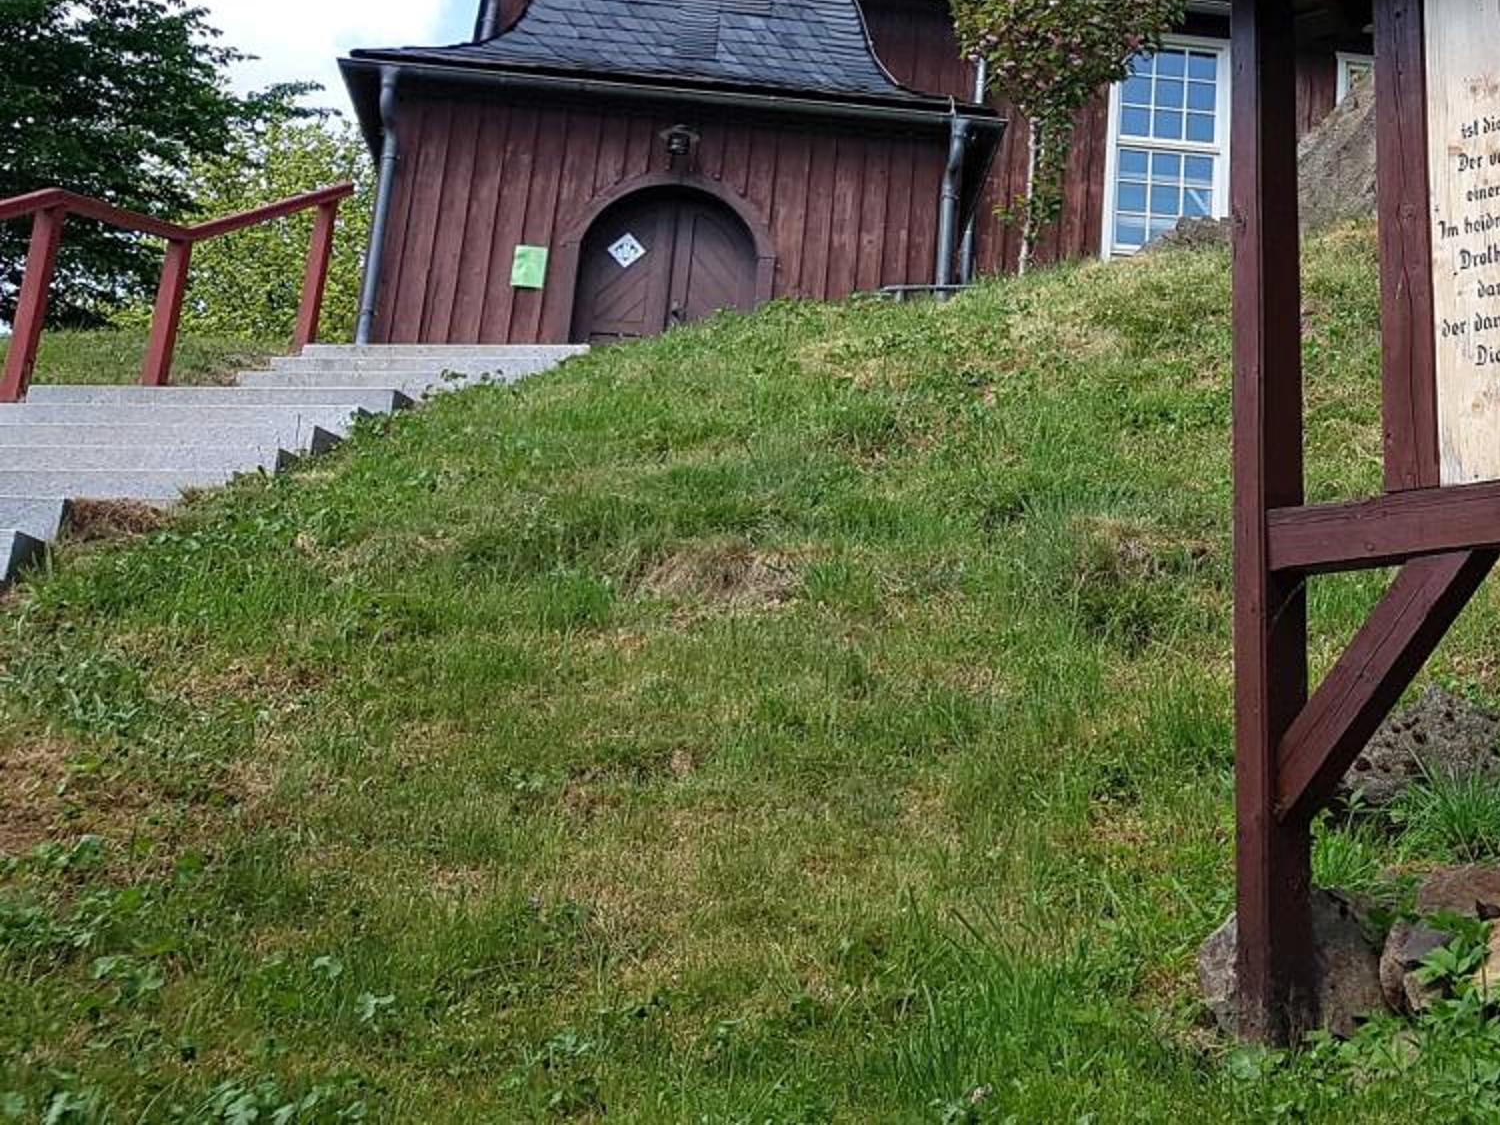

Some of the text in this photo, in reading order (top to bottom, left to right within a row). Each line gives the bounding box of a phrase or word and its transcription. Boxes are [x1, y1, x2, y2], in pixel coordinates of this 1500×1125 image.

[1460, 120, 1479, 140] ist
[1457, 152, 1483, 173] Der
[1466, 179, 1500, 202] einer
[1437, 220, 1460, 240] Im
[1441, 318, 1467, 338] der
